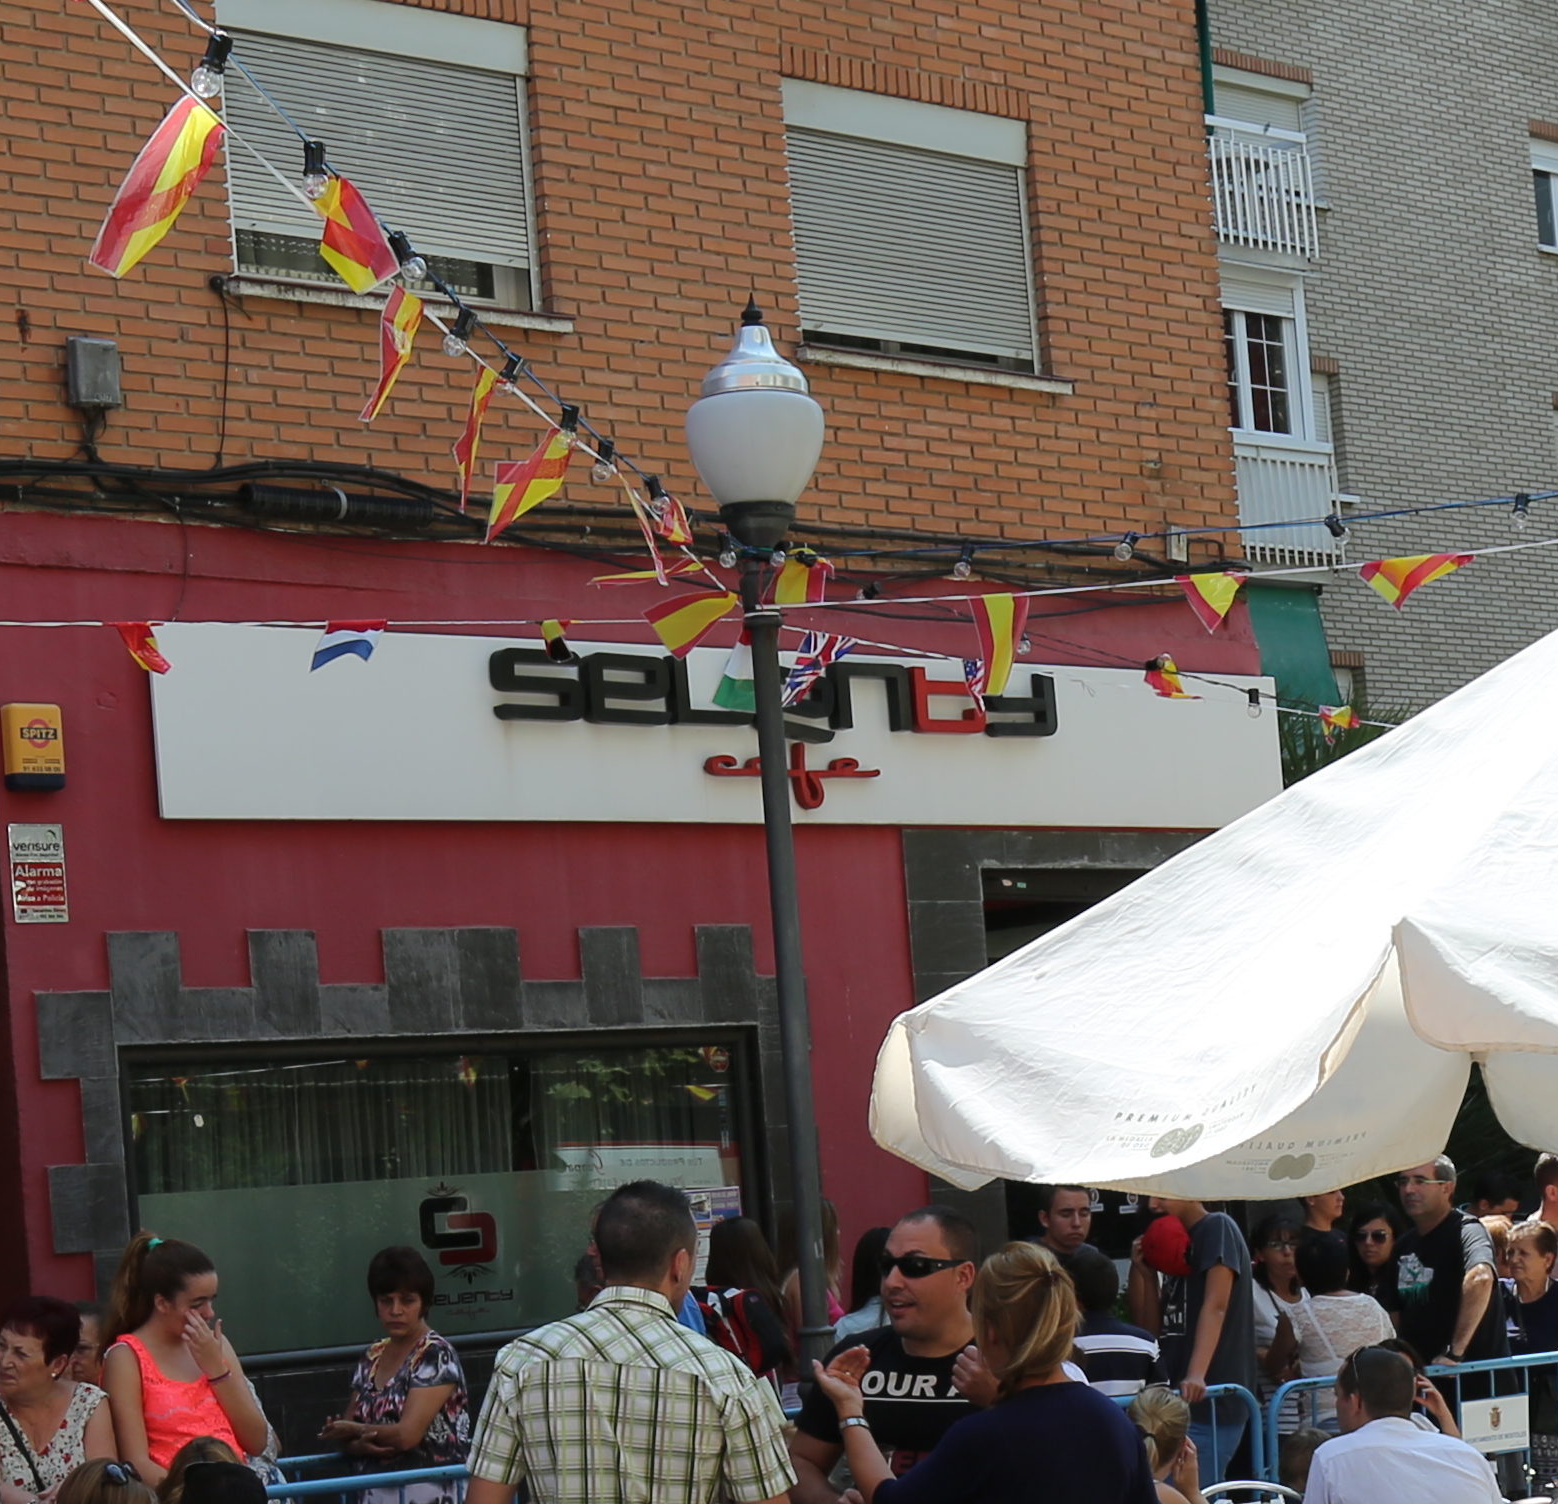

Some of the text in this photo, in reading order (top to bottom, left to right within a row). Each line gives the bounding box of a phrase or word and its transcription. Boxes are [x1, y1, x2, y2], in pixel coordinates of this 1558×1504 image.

[21, 728, 56, 739] SPITZ
[12, 841, 61, 852] verisure
[14, 864, 63, 878] Alarma
[1113, 1111, 1193, 1123] PREMIUM
[430, 1288, 514, 1307] eventy
